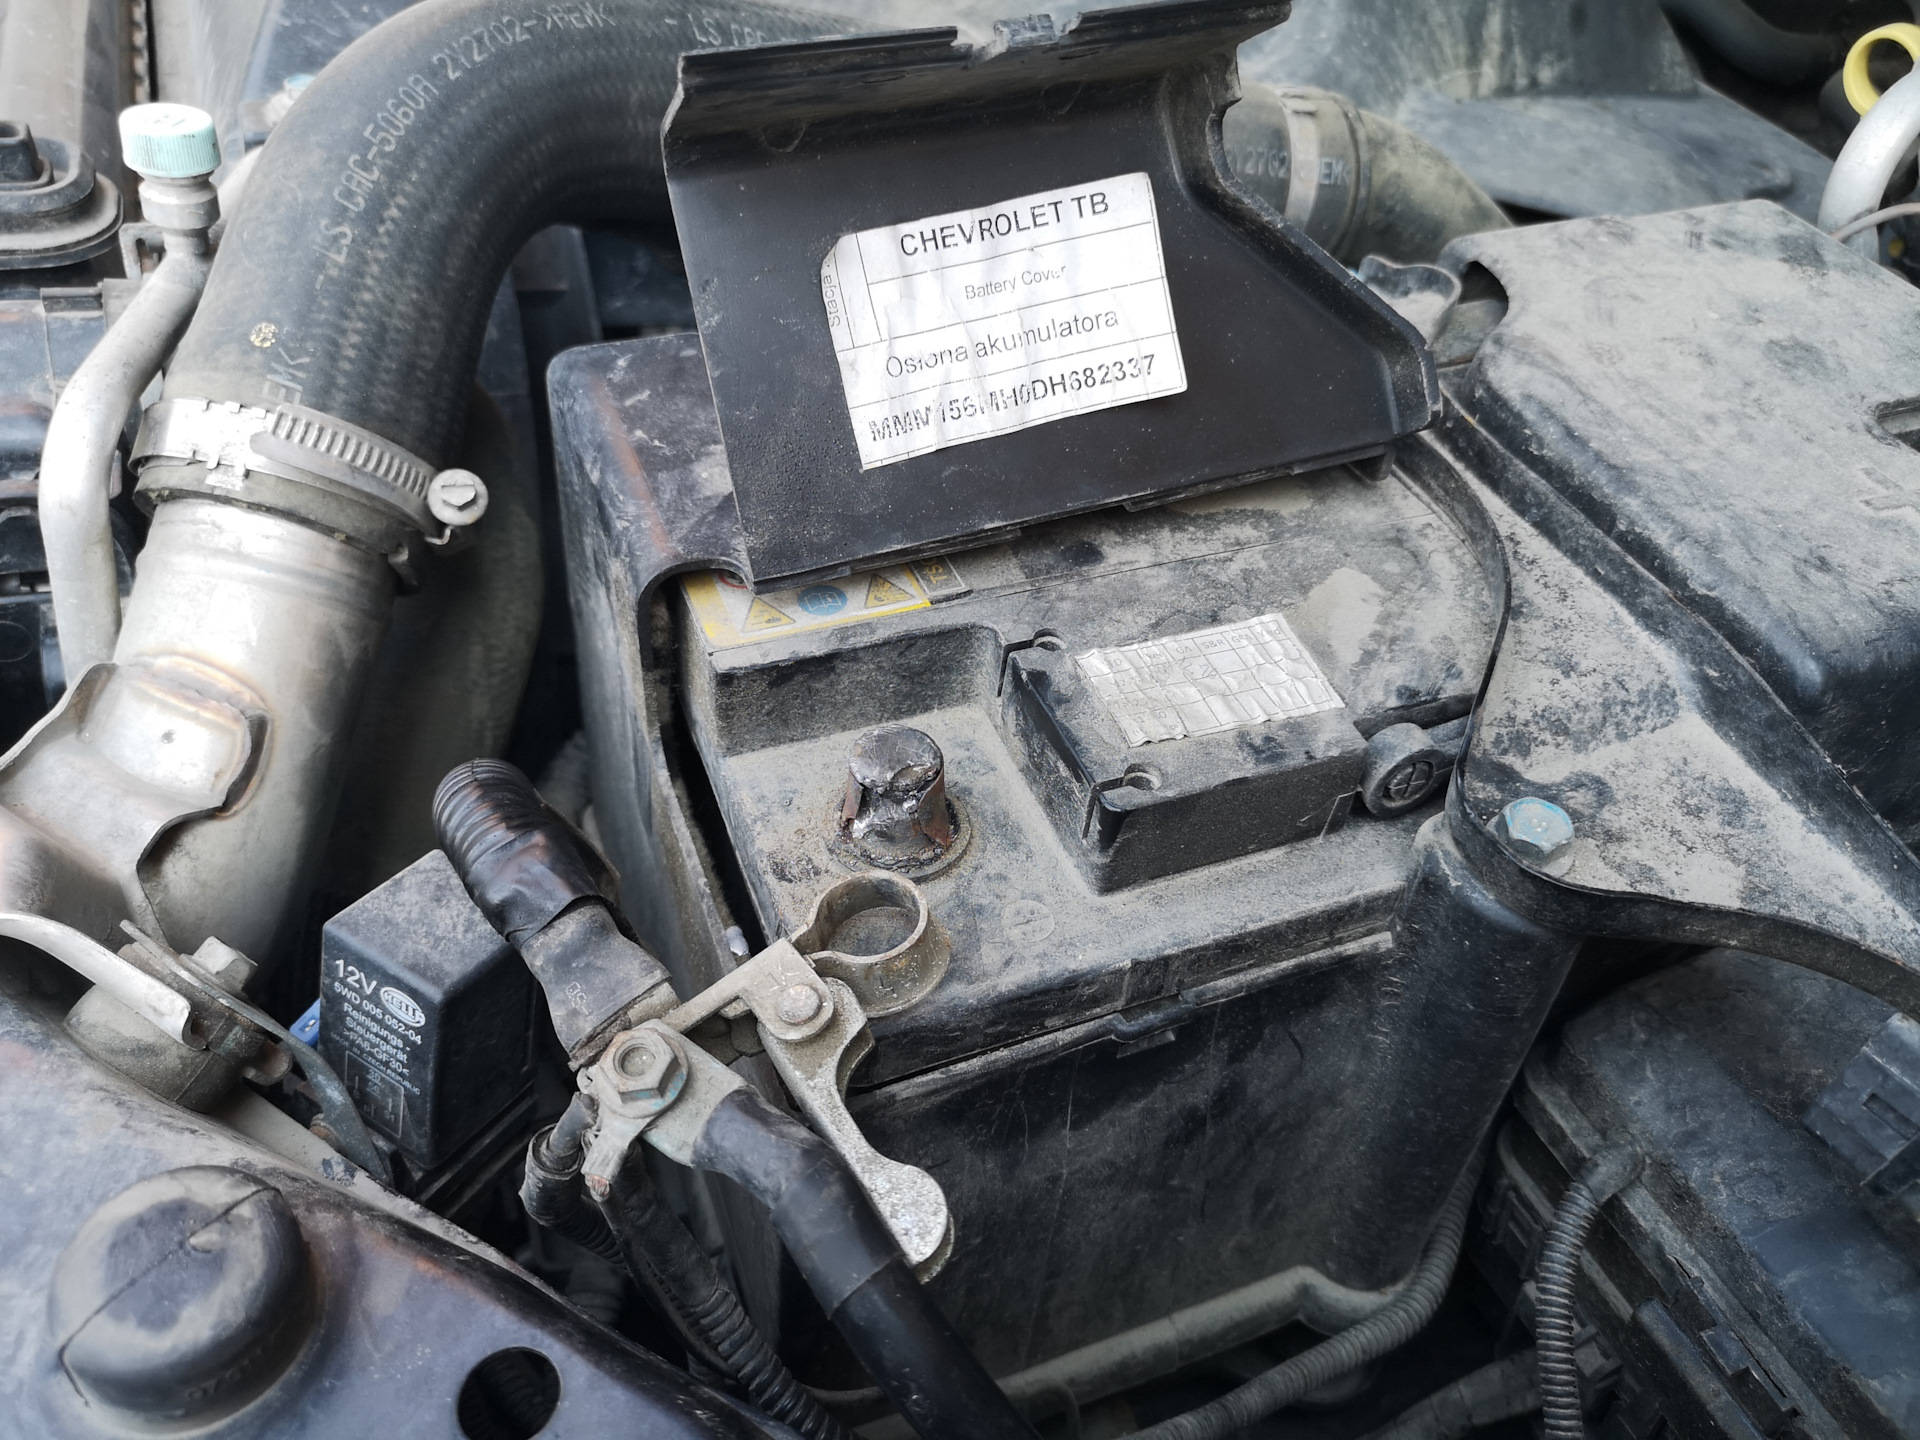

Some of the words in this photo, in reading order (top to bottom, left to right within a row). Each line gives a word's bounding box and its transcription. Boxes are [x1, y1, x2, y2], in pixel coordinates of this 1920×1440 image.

[900, 200, 1064, 257] CHEVROLET
[1071, 191, 1110, 221] TB
[965, 275, 1017, 301] Battery
[1021, 264, 1067, 287] Cover
[975, 307, 1120, 358] akumulatora
[335, 959, 378, 995] 12V
[334, 981, 361, 1005] 5WD
[362, 1000, 383, 1019] 005
[384, 1015, 423, 1046] 052-04
